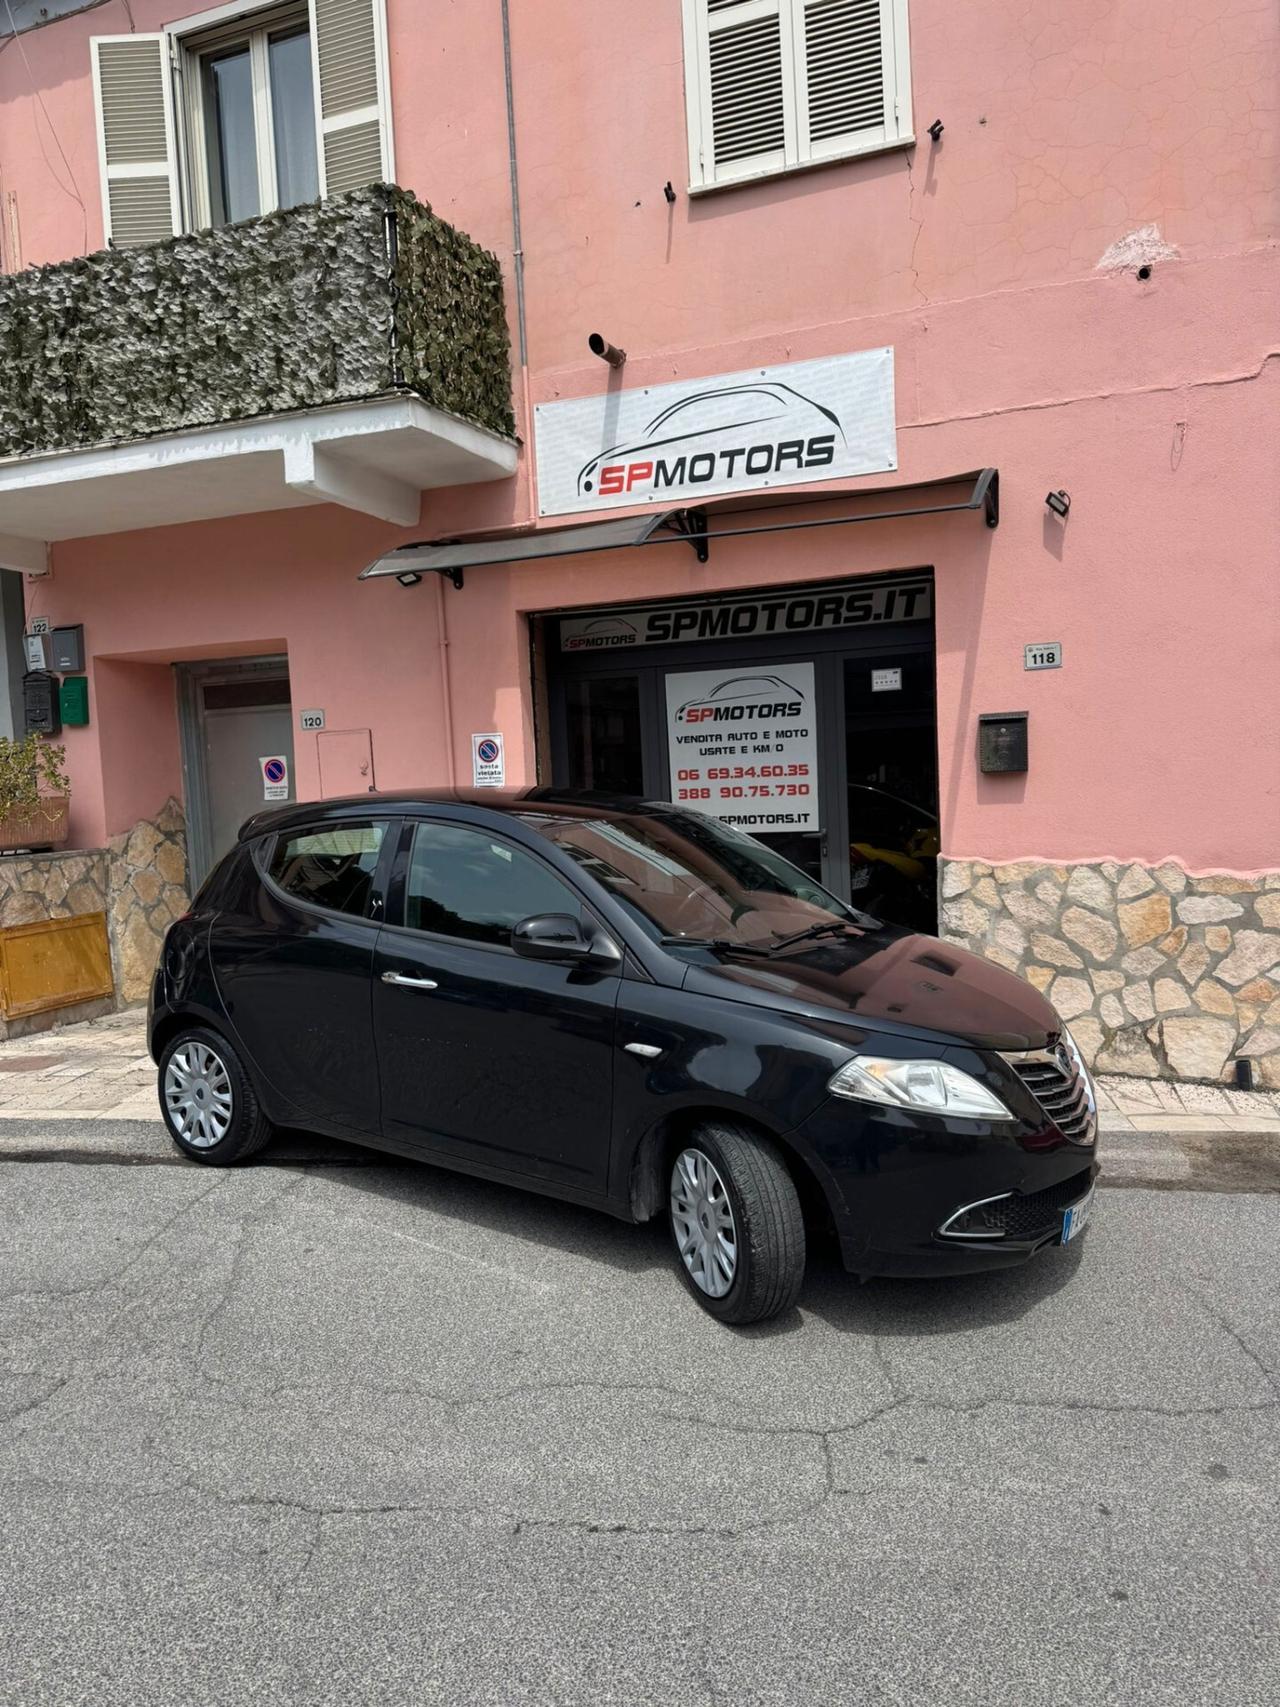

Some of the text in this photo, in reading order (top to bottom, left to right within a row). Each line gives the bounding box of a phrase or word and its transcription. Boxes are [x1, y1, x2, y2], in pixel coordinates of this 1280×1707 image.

[599, 434, 835, 495] SPMOTORS
[645, 587, 926, 641] SPMOTORS.IT
[33, 624, 47, 633] 122
[569, 634, 636, 648] SPMOTORS
[1032, 652, 1055, 664] 118
[686, 702, 802, 723] SPMOTORS
[304, 717, 322, 727] 120
[676, 729, 808, 744] VENDITA AUTO E MOTO
[699, 746, 736, 756] USATE
[741, 745, 748, 754] E
[677, 764, 809, 781] 06 69.34.60.35
[678, 784, 810, 800] 388 90.75.730
[712, 813, 810, 825] SPMOTORS.IT
